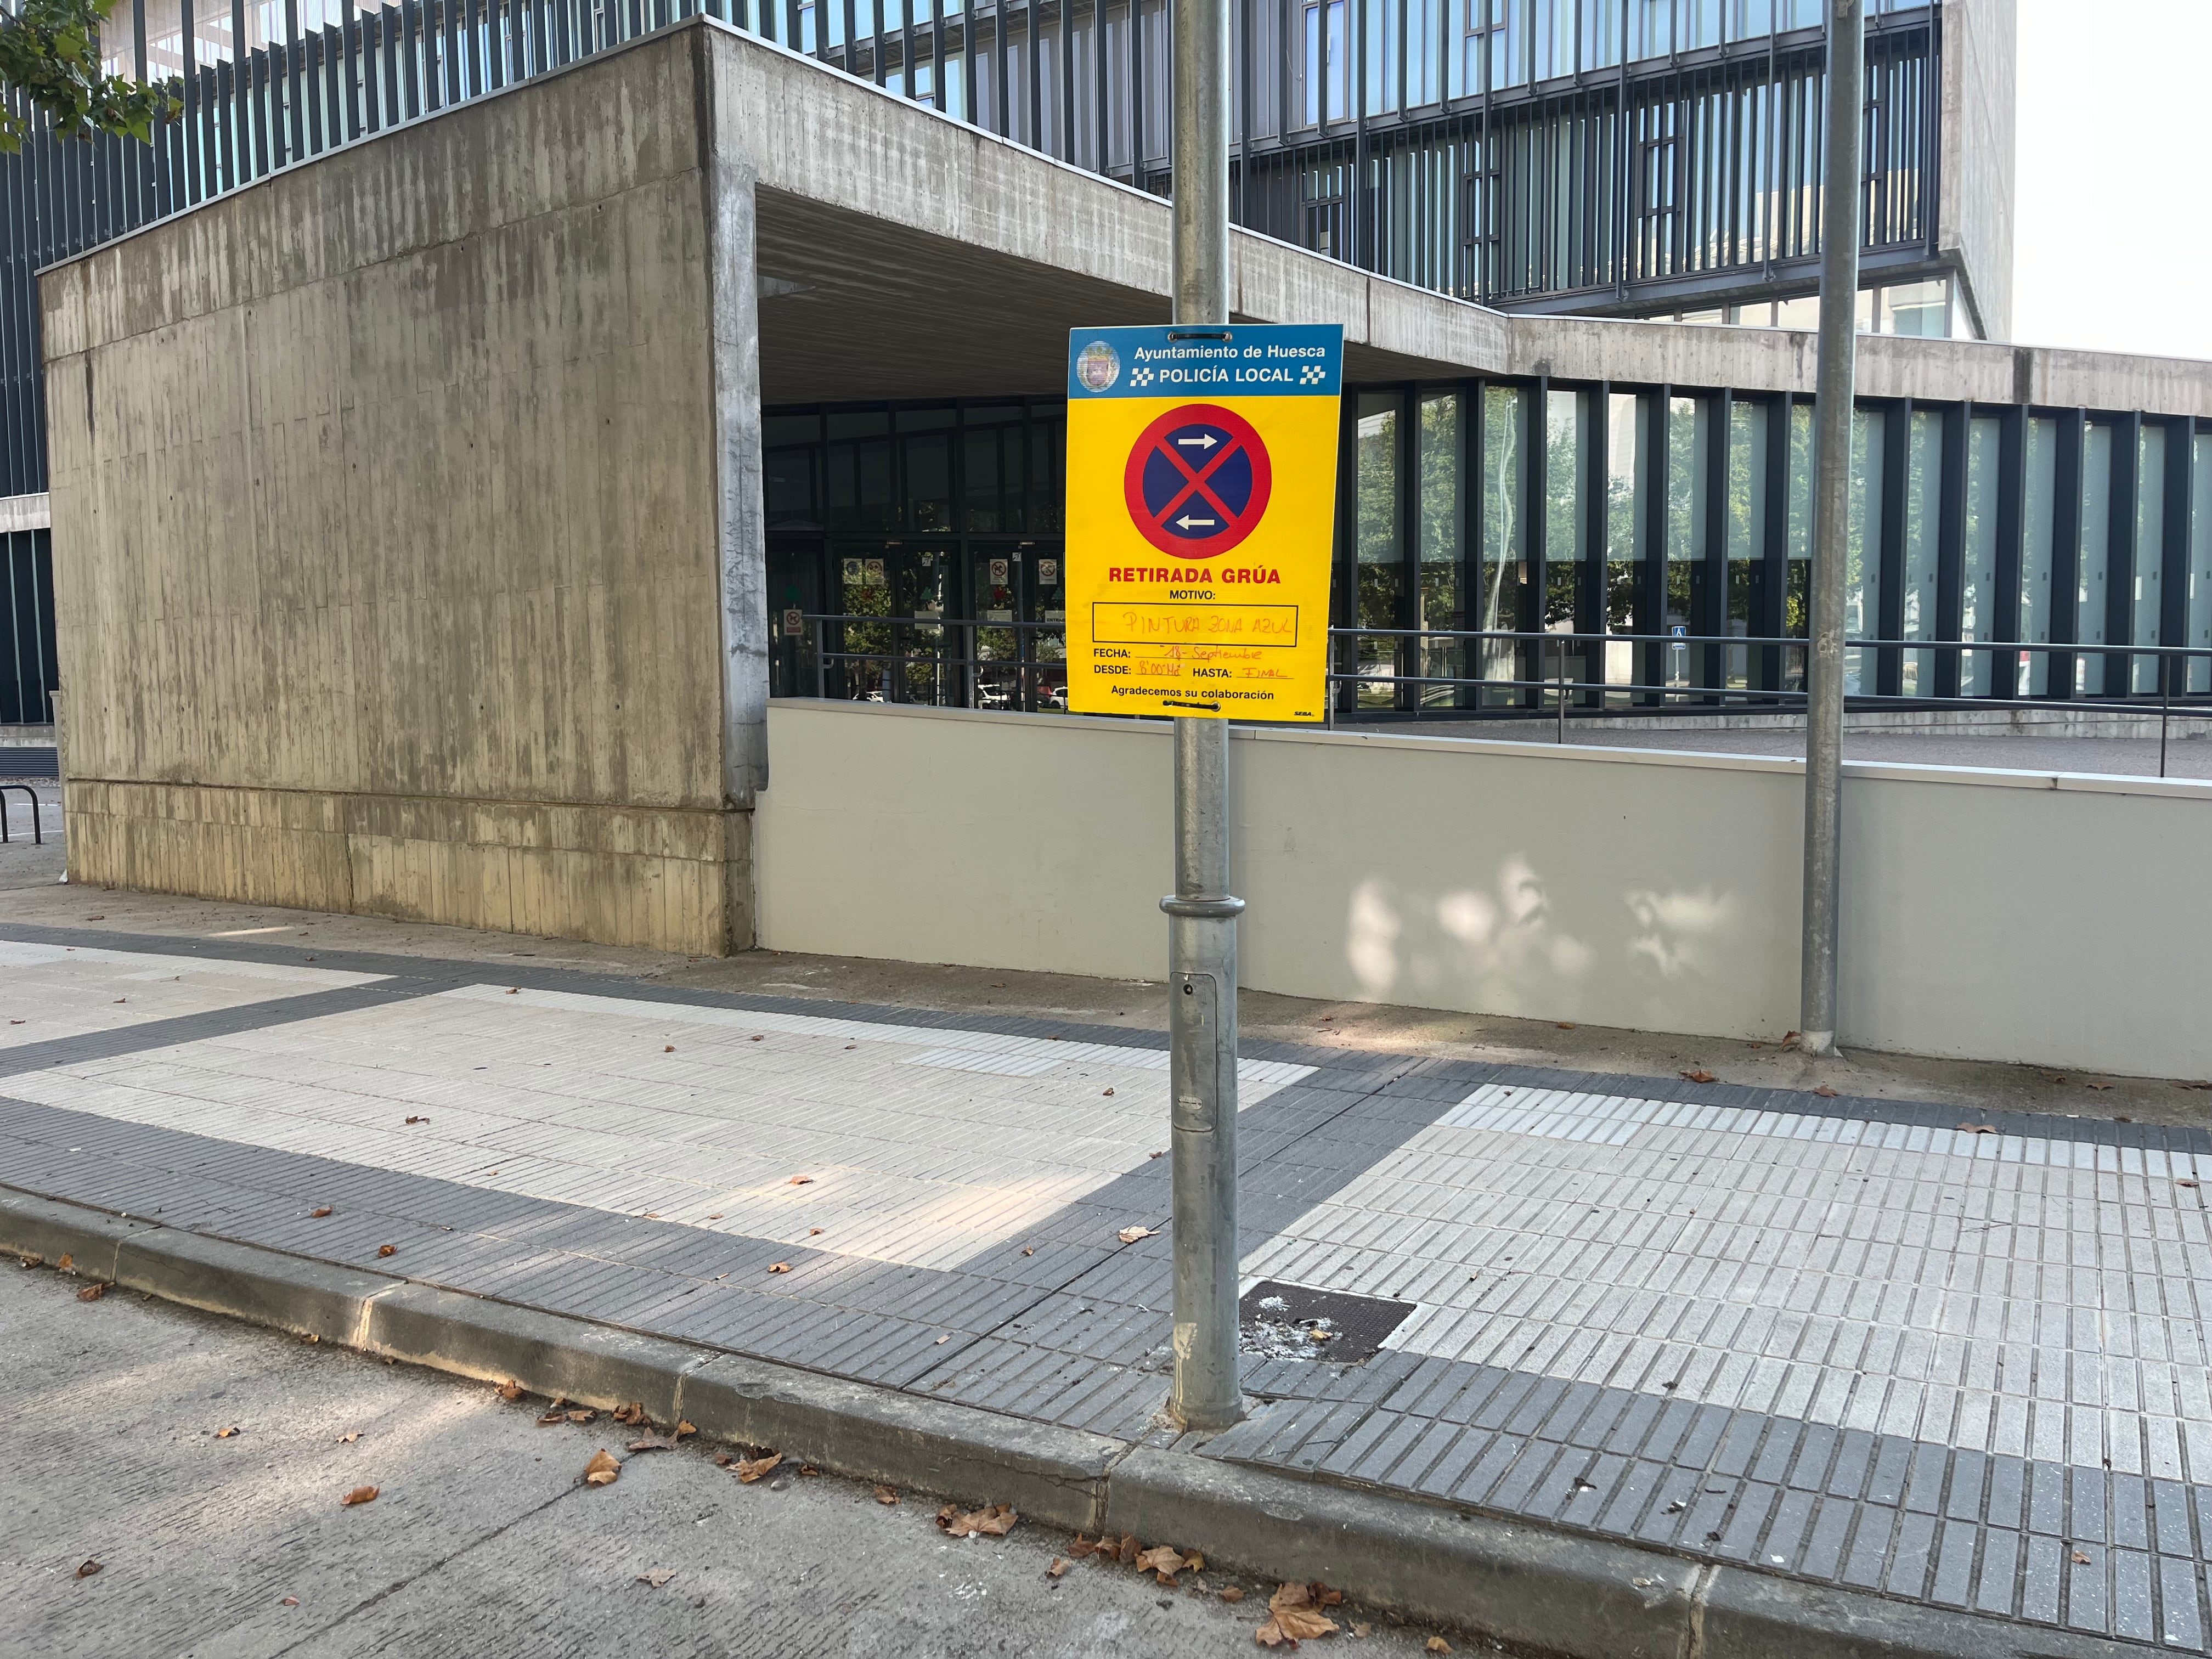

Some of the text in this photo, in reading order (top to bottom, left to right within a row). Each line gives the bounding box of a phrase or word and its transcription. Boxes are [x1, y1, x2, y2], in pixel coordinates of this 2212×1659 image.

[1134, 345, 1325, 362] Ayuntamiento de Huesca
[1159, 365, 1294, 383] POLICÍA LOCAL
[1109, 565, 1282, 584] RETIRADA GRÚA
[1169, 590, 1216, 600] MOTIVO:
[1122, 612, 1293, 634] PINTURA ZONA AZUL
[1093, 648, 1131, 658] FECHA:
[1093, 664, 1132, 675] DESDE:
[1193, 668, 1232, 678] HASTA:
[1242, 668, 1288, 678] FINAL
[1111, 685, 1182, 697] Agradecemos
[1201, 689, 1274, 701] colaboración
